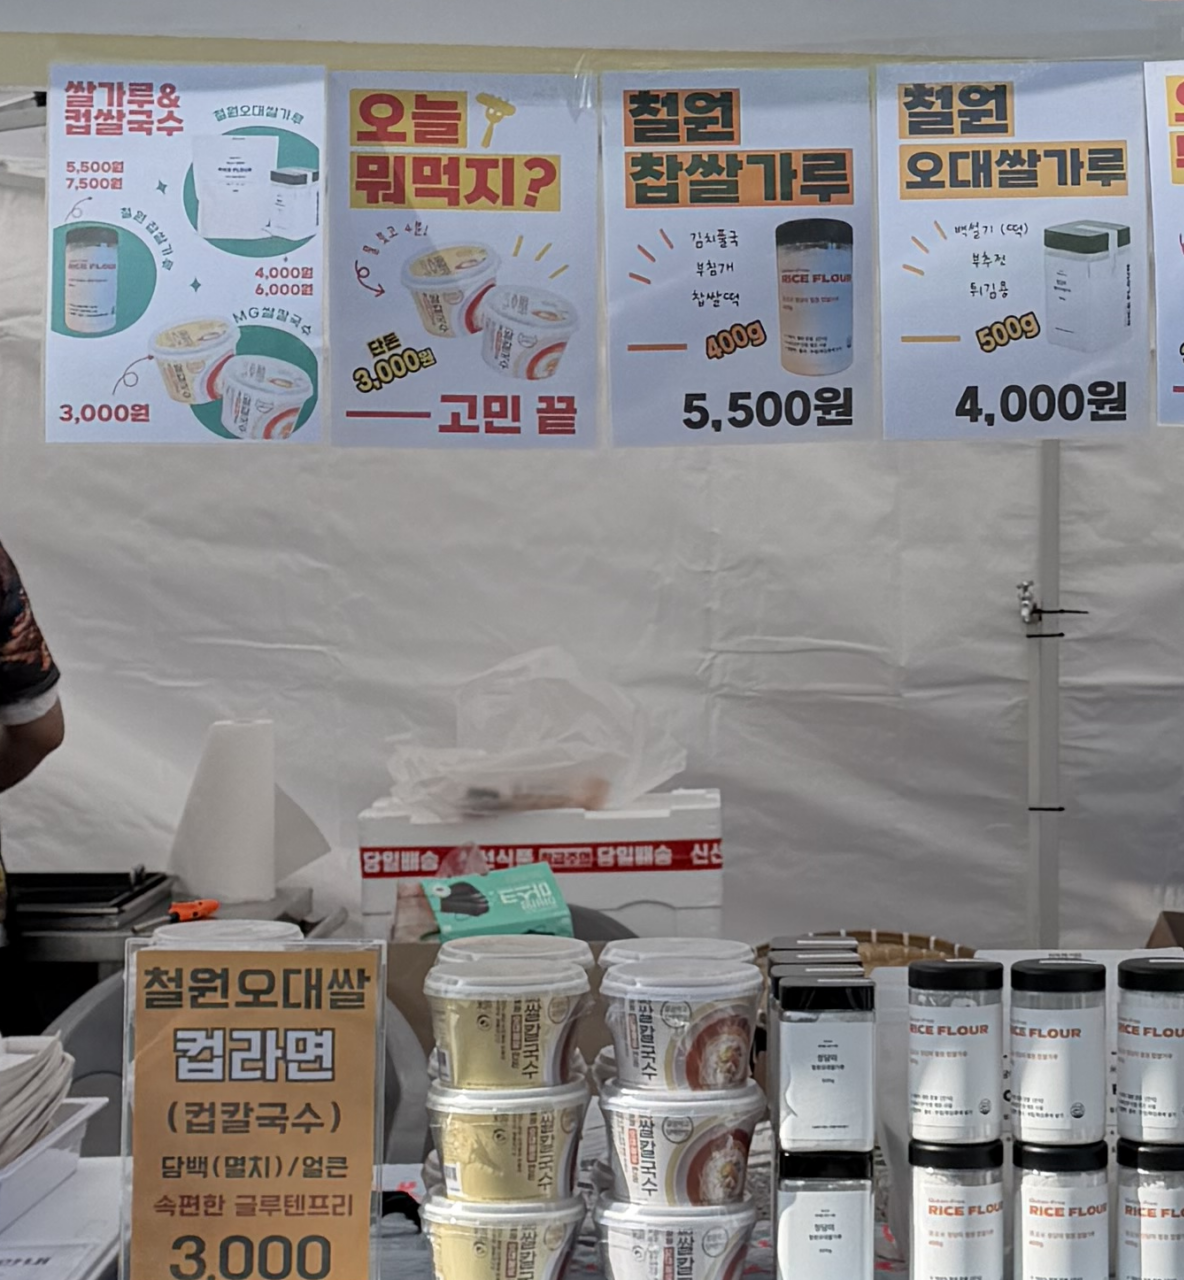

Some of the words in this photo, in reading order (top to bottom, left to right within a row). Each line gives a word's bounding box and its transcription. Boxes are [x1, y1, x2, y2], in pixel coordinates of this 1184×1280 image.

[64, 81, 181, 108] 쌀가루&
[356, 93, 461, 144] 오늘
[629, 90, 734, 142] 철원
[904, 83, 1008, 136] 철원
[64, 109, 184, 136] 컵쌀국수
[66, 161, 124, 174] 5,500원
[629, 153, 850, 204] 찹쌀가루
[906, 148, 1126, 189] 오대쌀가루
[66, 178, 123, 191] 7,500원
[355, 155, 556, 207] 뭐먹지?
[690, 229, 739, 248] 김치풀국
[954, 222, 995, 238] 백설기
[1000, 222, 1029, 237] (떡)
[696, 262, 734, 275] 부침개
[972, 252, 1006, 266] 부추전
[255, 267, 313, 280] 4,000원
[255, 284, 313, 297] 6,000원
[692, 291, 740, 307] 찹쌀떡
[970, 281, 1008, 299] 튀김용
[706, 320, 767, 360] 400g
[976, 312, 1041, 352] 500g
[353, 348, 437, 393] 3,000원
[59, 404, 150, 425] 3,000원
[683, 387, 853, 432] 5,500원
[955, 380, 1127, 426] 4,000원
[438, 395, 521, 434] 고민
[537, 396, 577, 435] 끝
[143, 967, 371, 1009] 철원오대쌀
[937, 1024, 989, 1036] FLOUR
[1029, 1028, 1081, 1039] FLOUR
[174, 1027, 335, 1082] 컵라면
[168, 1102, 342, 1134] (컵칼국수)
[162, 1156, 348, 1179] 담백(멸치)/얼큰
[154, 1194, 226, 1216] 속편한
[235, 1194, 353, 1216] 글루텐프리
[928, 1205, 962, 1216] RICE
[1029, 1205, 1064, 1217] RICE
[1125, 1206, 1157, 1218] RICE
